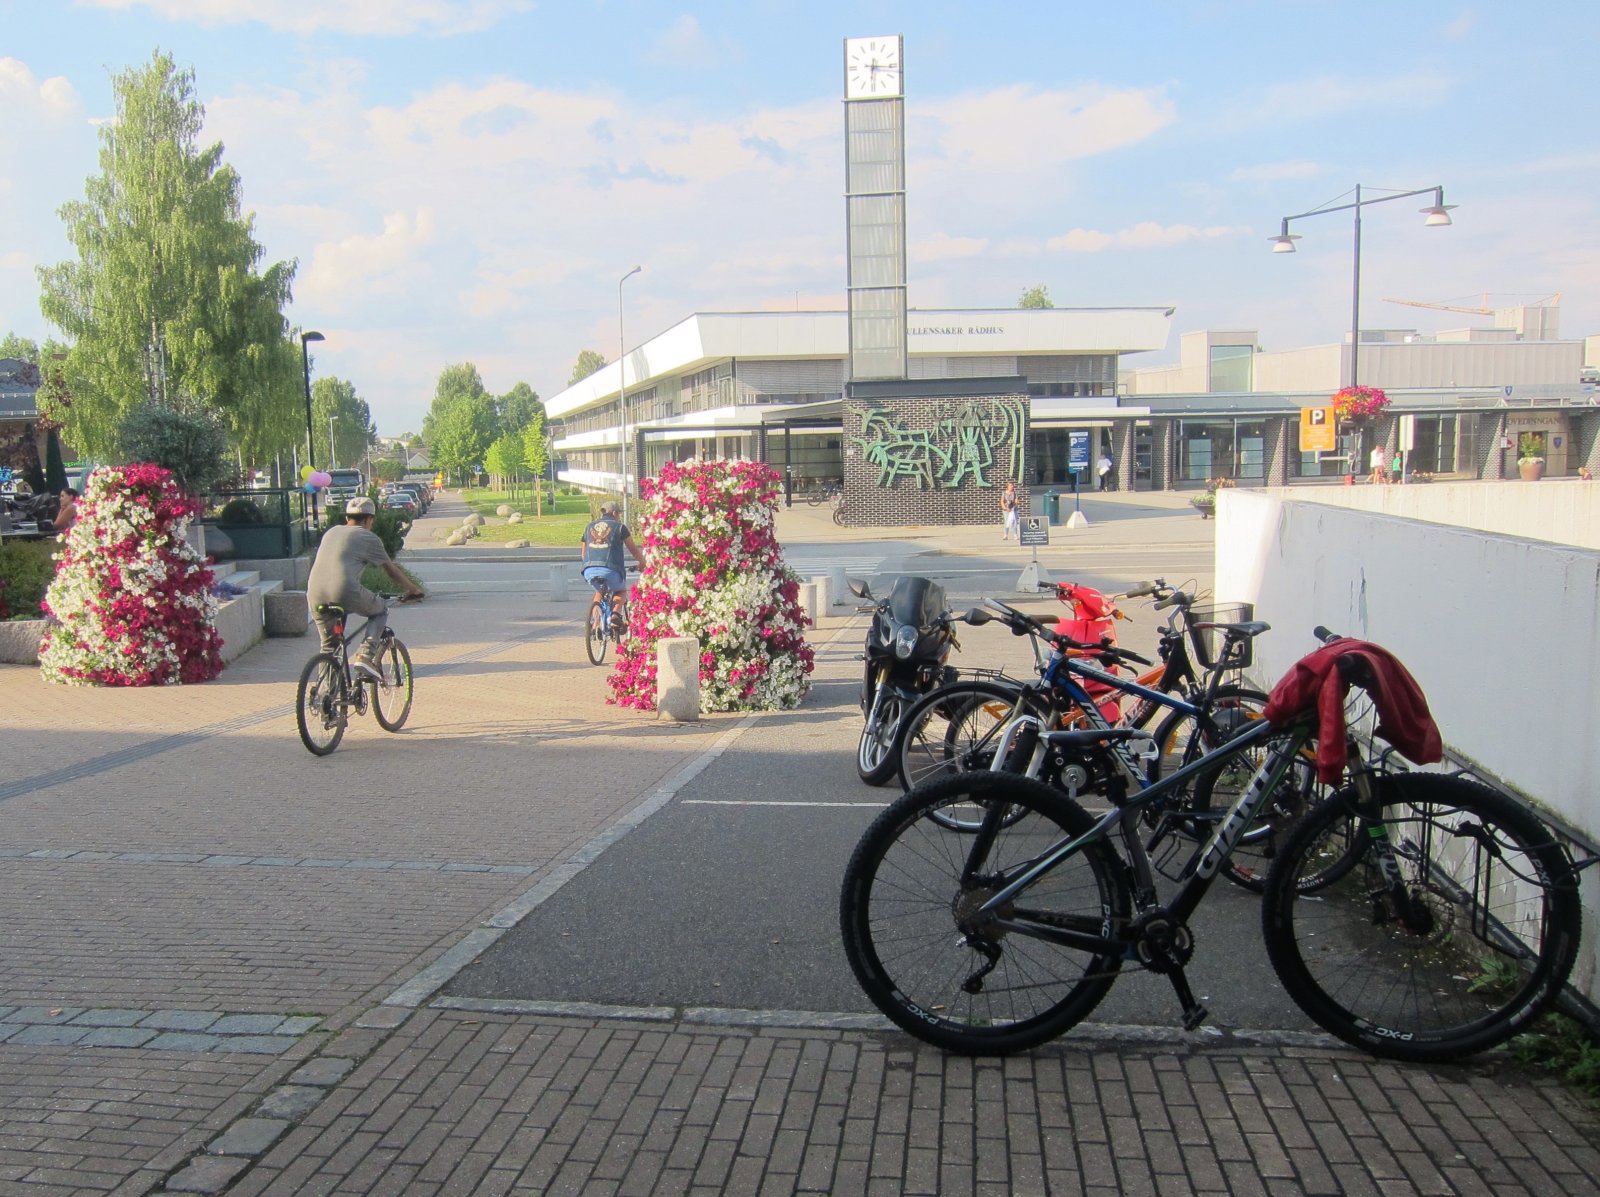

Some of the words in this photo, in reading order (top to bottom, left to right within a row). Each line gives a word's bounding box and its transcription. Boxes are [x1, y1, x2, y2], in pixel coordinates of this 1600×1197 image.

[906, 327, 963, 336] ULLENSAKER
[968, 325, 1004, 335] RÅDHUS
[1312, 410, 1324, 425] P
[1070, 437, 1078, 447] P
[1196, 754, 1275, 879] GIANT
